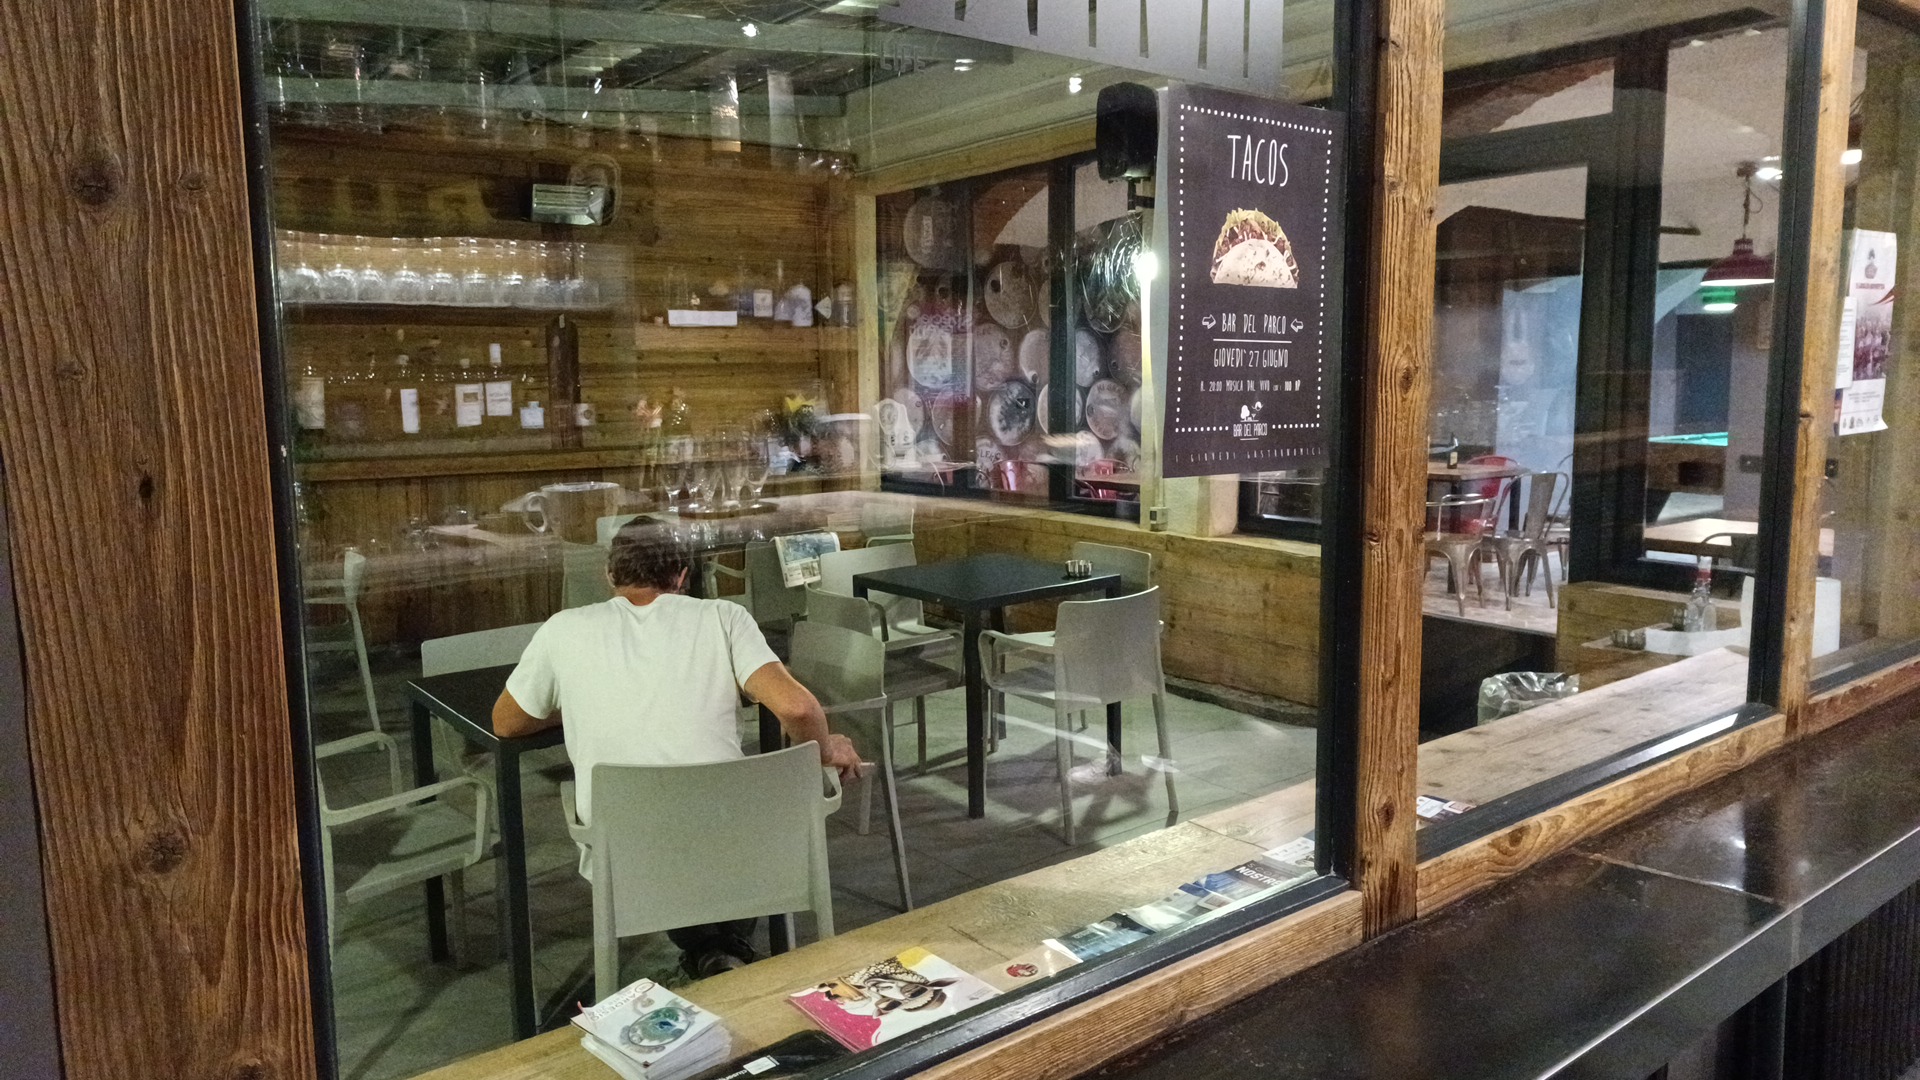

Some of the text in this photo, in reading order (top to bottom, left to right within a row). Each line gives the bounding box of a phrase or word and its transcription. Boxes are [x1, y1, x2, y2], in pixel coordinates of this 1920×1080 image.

[1227, 134, 1289, 187] TACOS
[1221, 312, 1287, 335] BAR DEL PARCO
[1248, 350, 1260, 368] 27
[1262, 348, 1289, 368] GIUGNO
[1225, 379, 1244, 392] MUSICA
[1246, 379, 1256, 392] DAL
[1259, 379, 1270, 392] VIVO
[1233, 422, 1268, 437] BAR DEL PARCO
[1246, 447, 1321, 460] GASTRONOMICI
